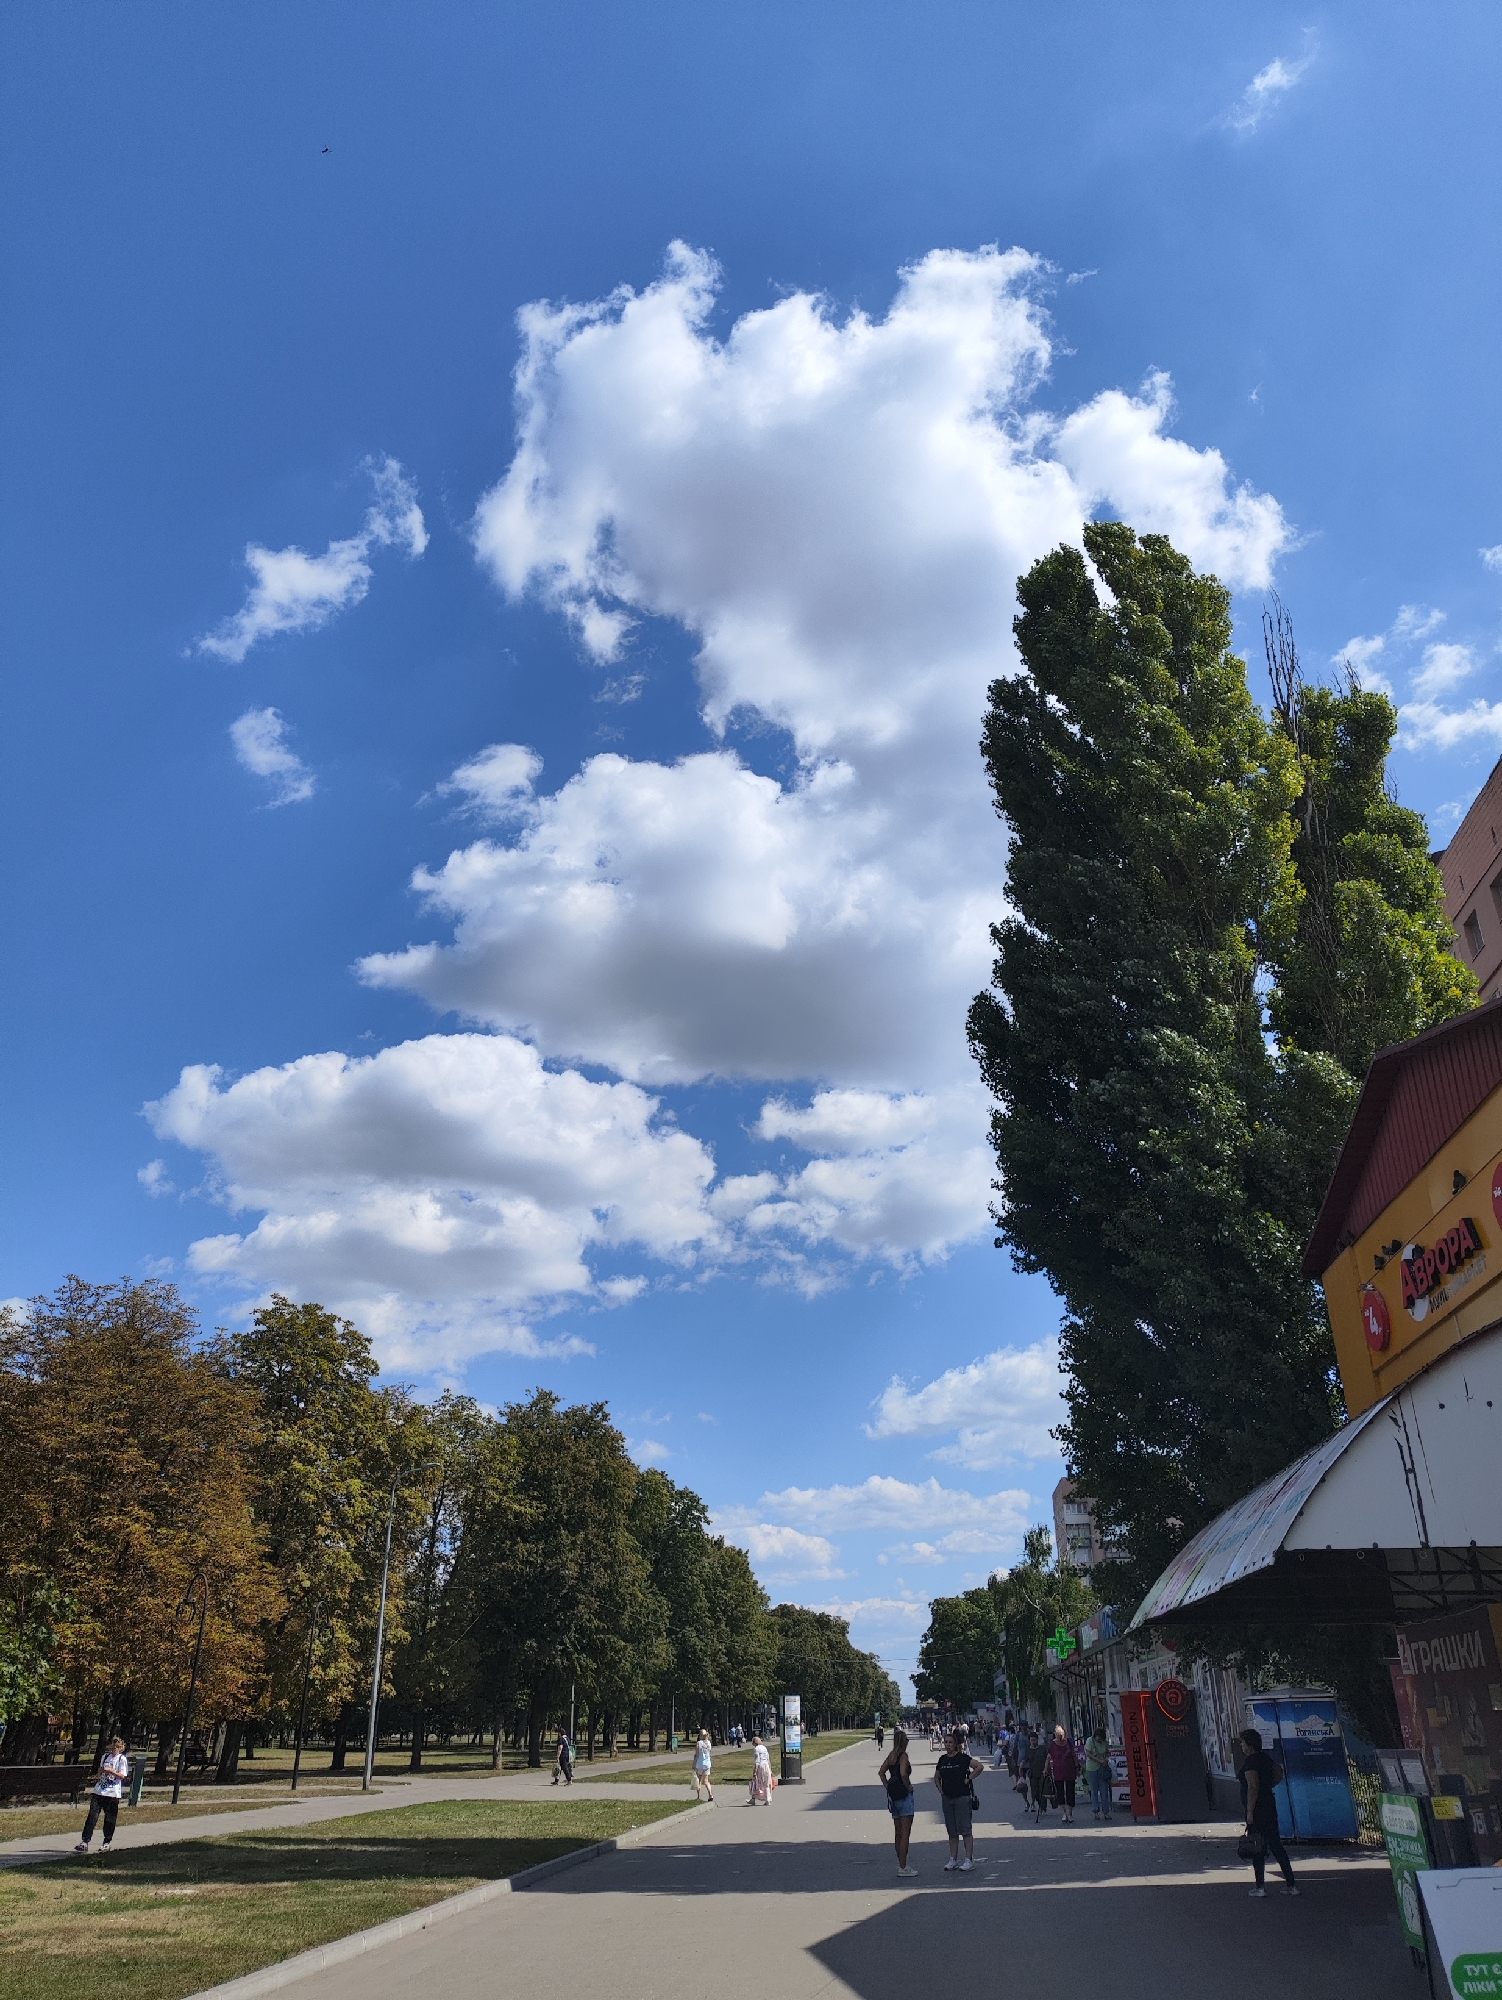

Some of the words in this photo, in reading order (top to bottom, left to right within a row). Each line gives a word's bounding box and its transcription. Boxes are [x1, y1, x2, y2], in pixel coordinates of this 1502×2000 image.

[1401, 1218, 1482, 1308] АВРОРА
[1132, 1746, 1146, 1797] COFFEE
[1463, 1964, 1488, 1976] ТУТ
[1463, 1980, 1497, 1994] ЛІКИ
